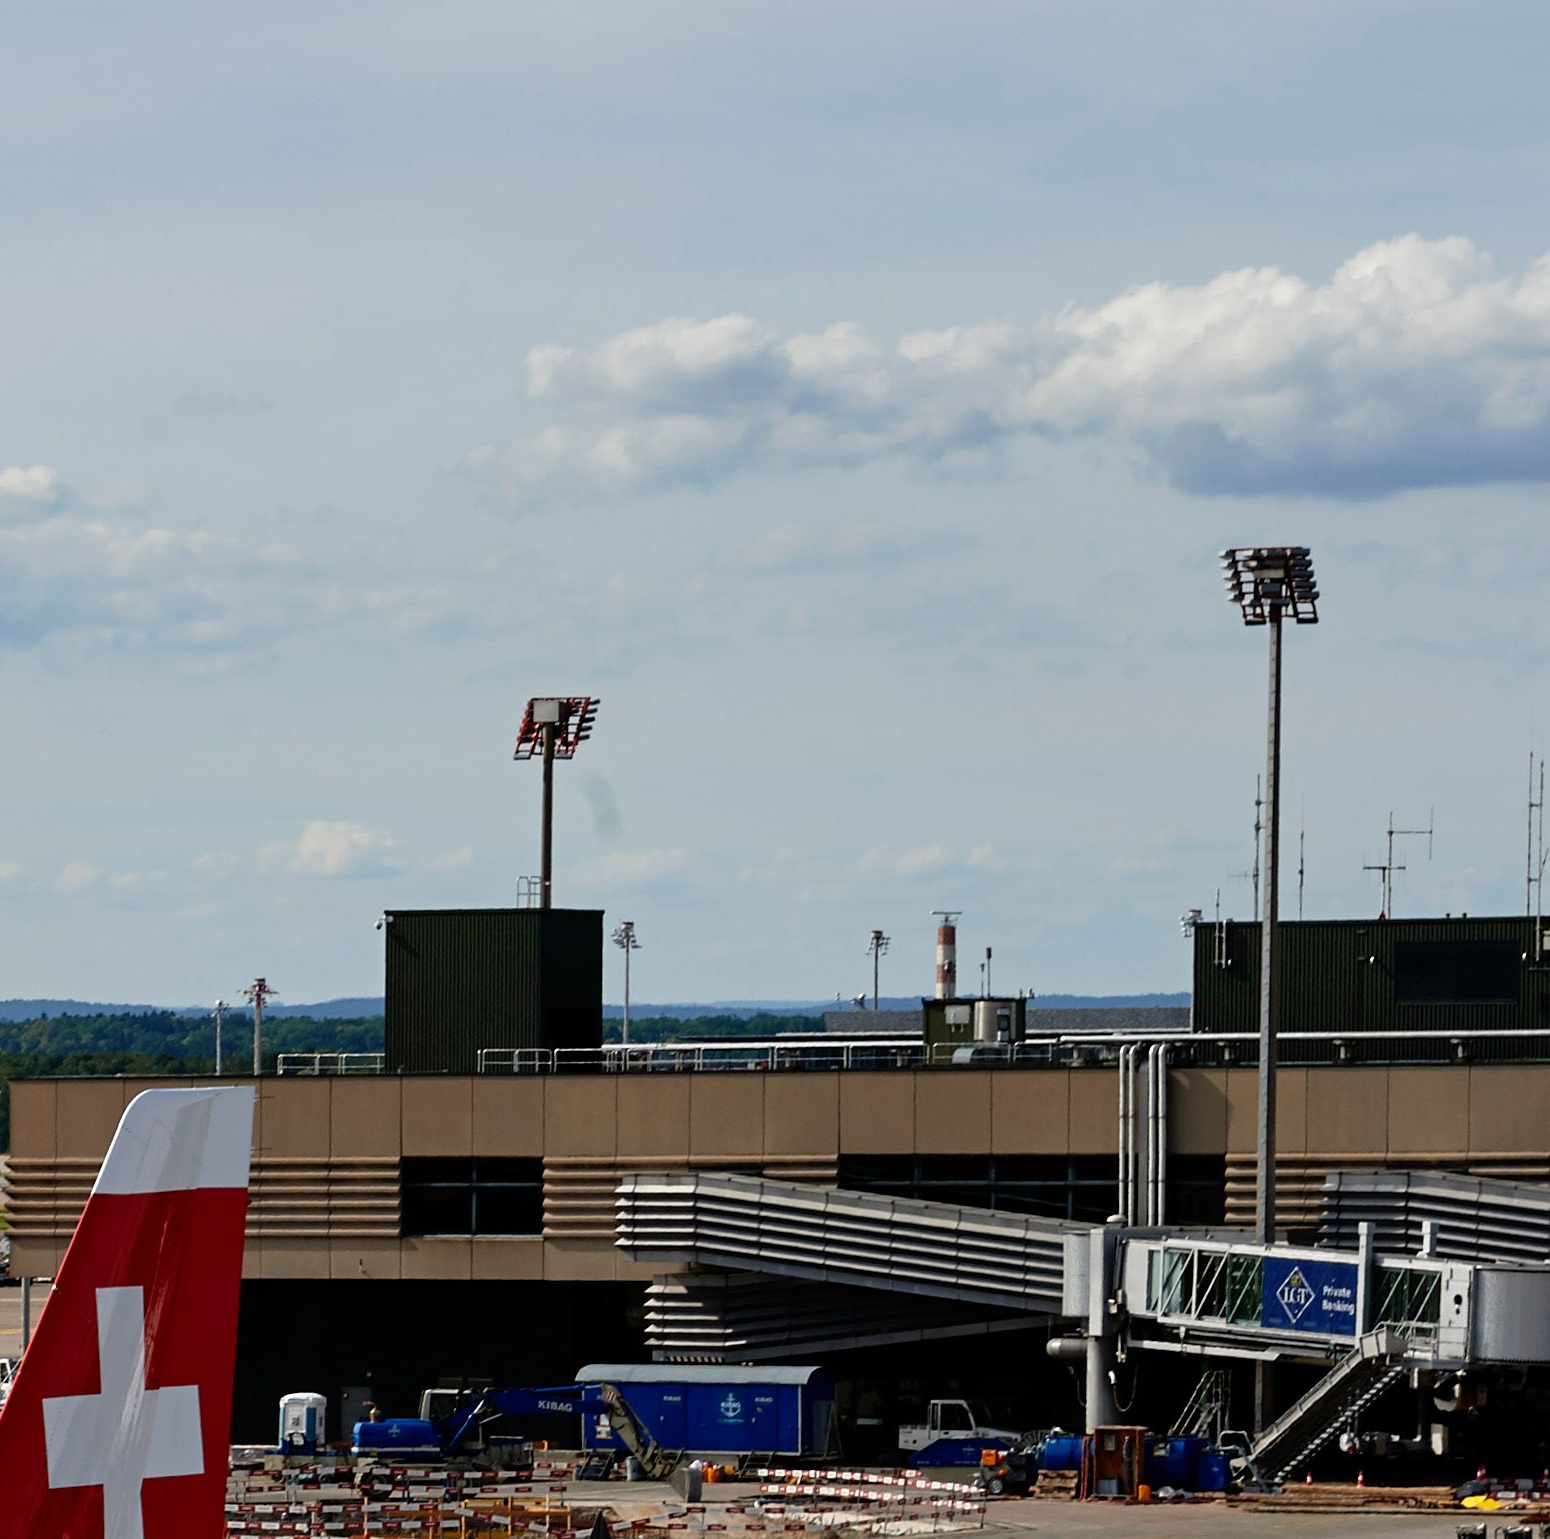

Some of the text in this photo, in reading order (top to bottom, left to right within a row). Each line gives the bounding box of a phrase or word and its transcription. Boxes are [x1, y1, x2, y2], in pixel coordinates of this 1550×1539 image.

[1283, 1286, 1309, 1304] LGT
[1322, 1286, 1351, 1298] Private
[1321, 1299, 1355, 1315] Banking
[538, 1400, 573, 1413] KIBAG
